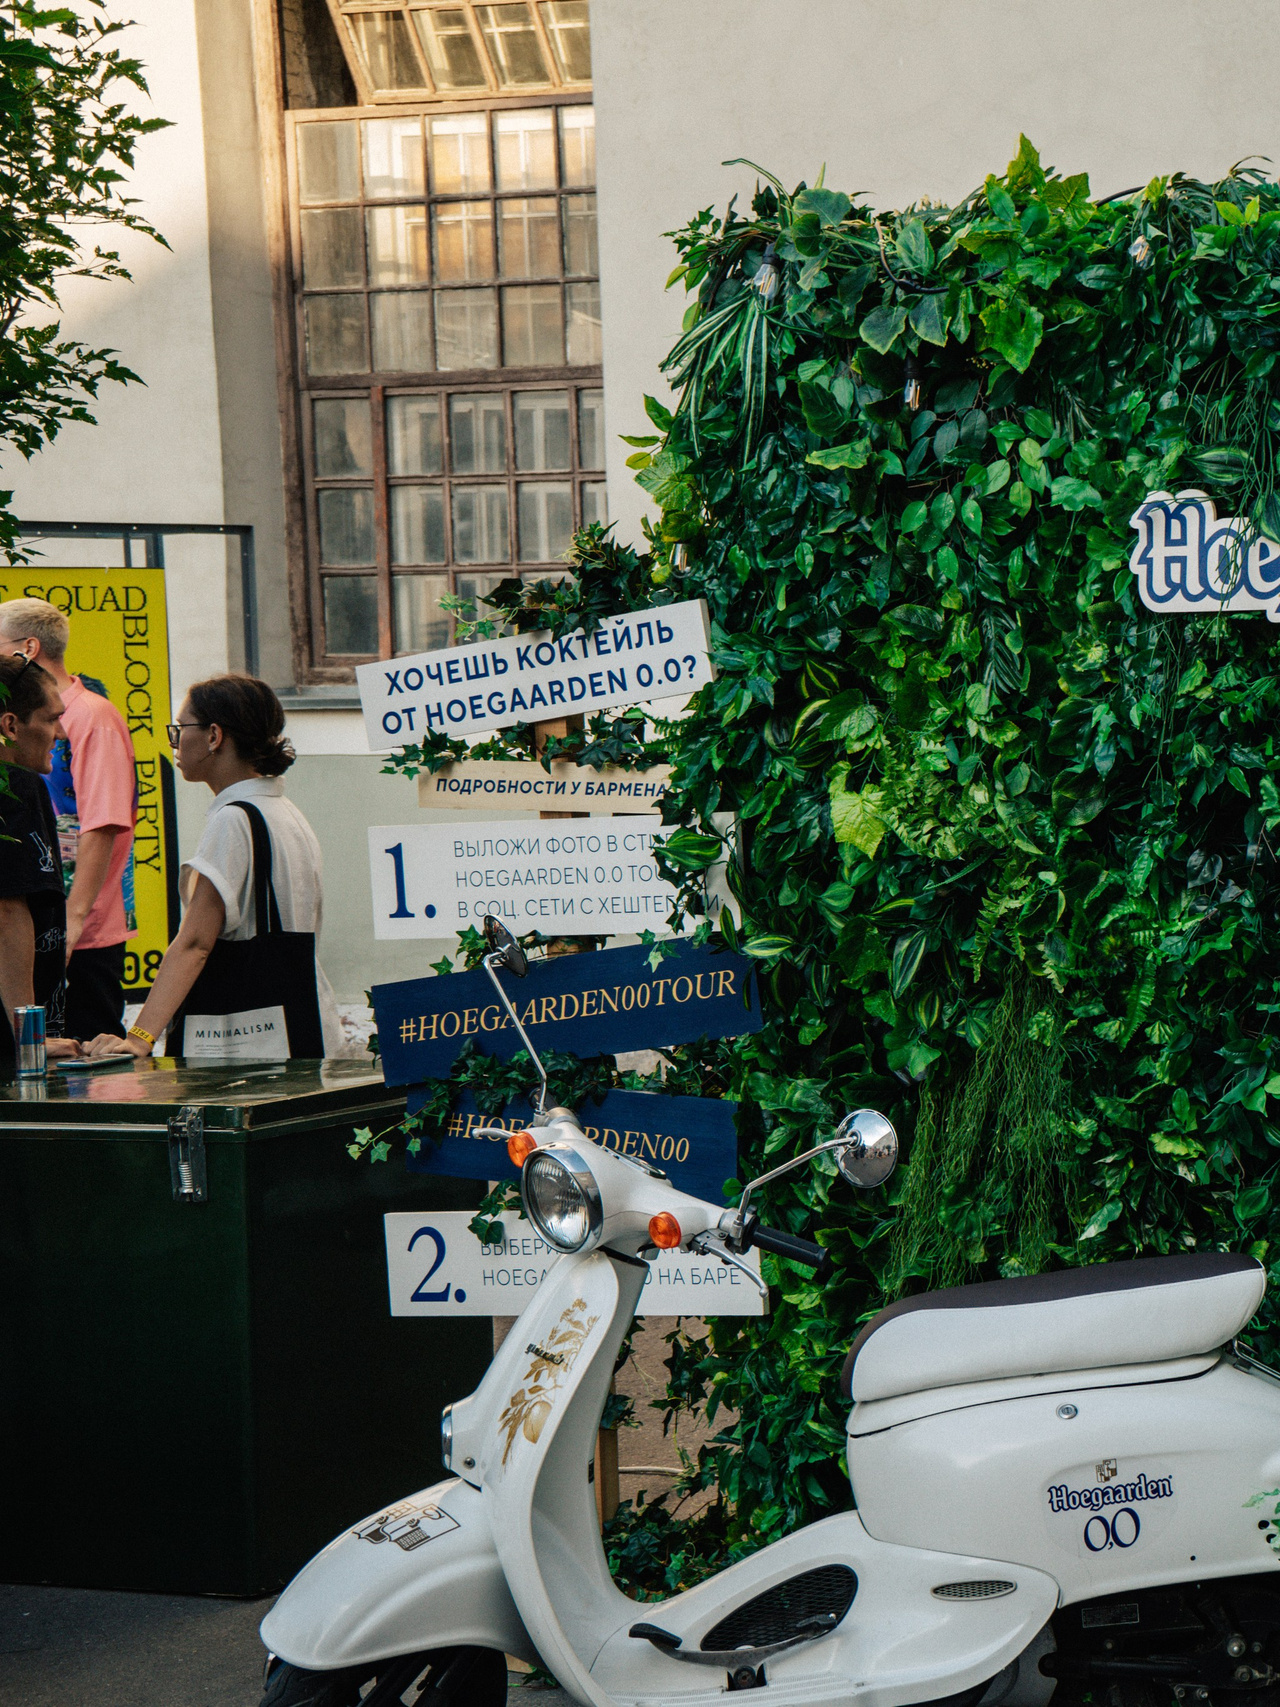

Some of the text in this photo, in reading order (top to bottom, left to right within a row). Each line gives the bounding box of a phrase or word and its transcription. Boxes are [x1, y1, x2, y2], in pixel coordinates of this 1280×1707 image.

[23, 586, 147, 617] SQUAD
[385, 619, 674, 696] ХОЧЕШЬ КОКТЕЙЛЬ
[382, 655, 697, 734] ОТ HOEGAARDEN 0.0?
[123, 613, 161, 874] BLOCK PARTY
[436, 778, 666, 797] ПОДРОБНОСТИ У БАРМЕНА
[454, 838, 540, 858] ВЫЛОЖИ
[546, 836, 601, 854] ФОТО
[607, 835, 618, 852] В
[385, 843, 437, 919] 1.
[456, 867, 589, 887] HOEGAARDEN
[594, 866, 623, 883] 0.0
[458, 901, 469, 918] В
[474, 900, 520, 919] СОЦ.
[525, 898, 575, 916] СЕТИ
[580, 898, 593, 914] С
[195, 1022, 275, 1038] MINIMALISM
[408, 1226, 467, 1303] 2.
[659, 1268, 686, 1285] НА
[691, 1267, 741, 1285] БАРЕ
[1048, 1473, 1173, 1512] Hoegaarden
